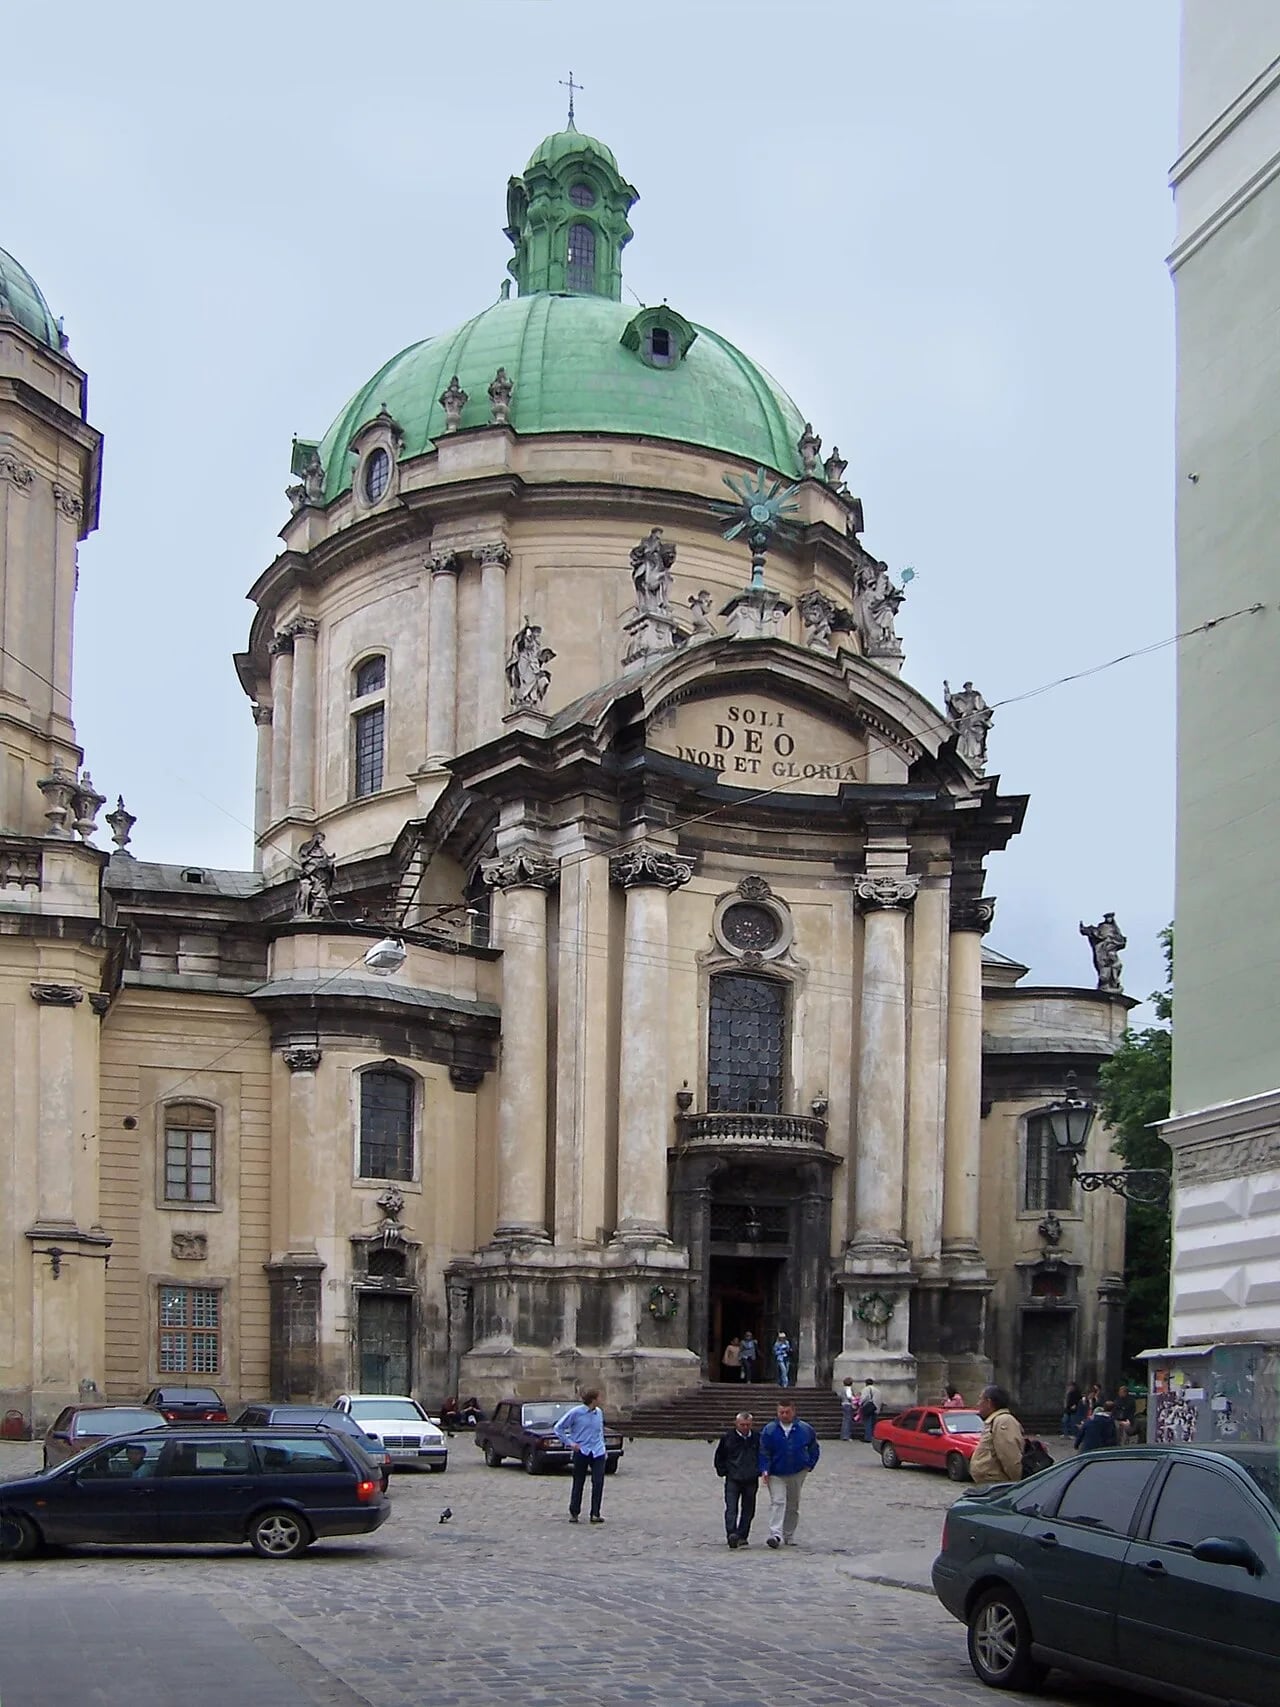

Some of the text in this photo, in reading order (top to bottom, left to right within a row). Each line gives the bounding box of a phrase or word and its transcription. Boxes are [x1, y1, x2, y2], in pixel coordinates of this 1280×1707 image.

[728, 706, 785, 728] SOLI
[715, 724, 794, 757] DEO
[734, 756, 761, 774] ET
[772, 761, 858, 781] GLORIA
